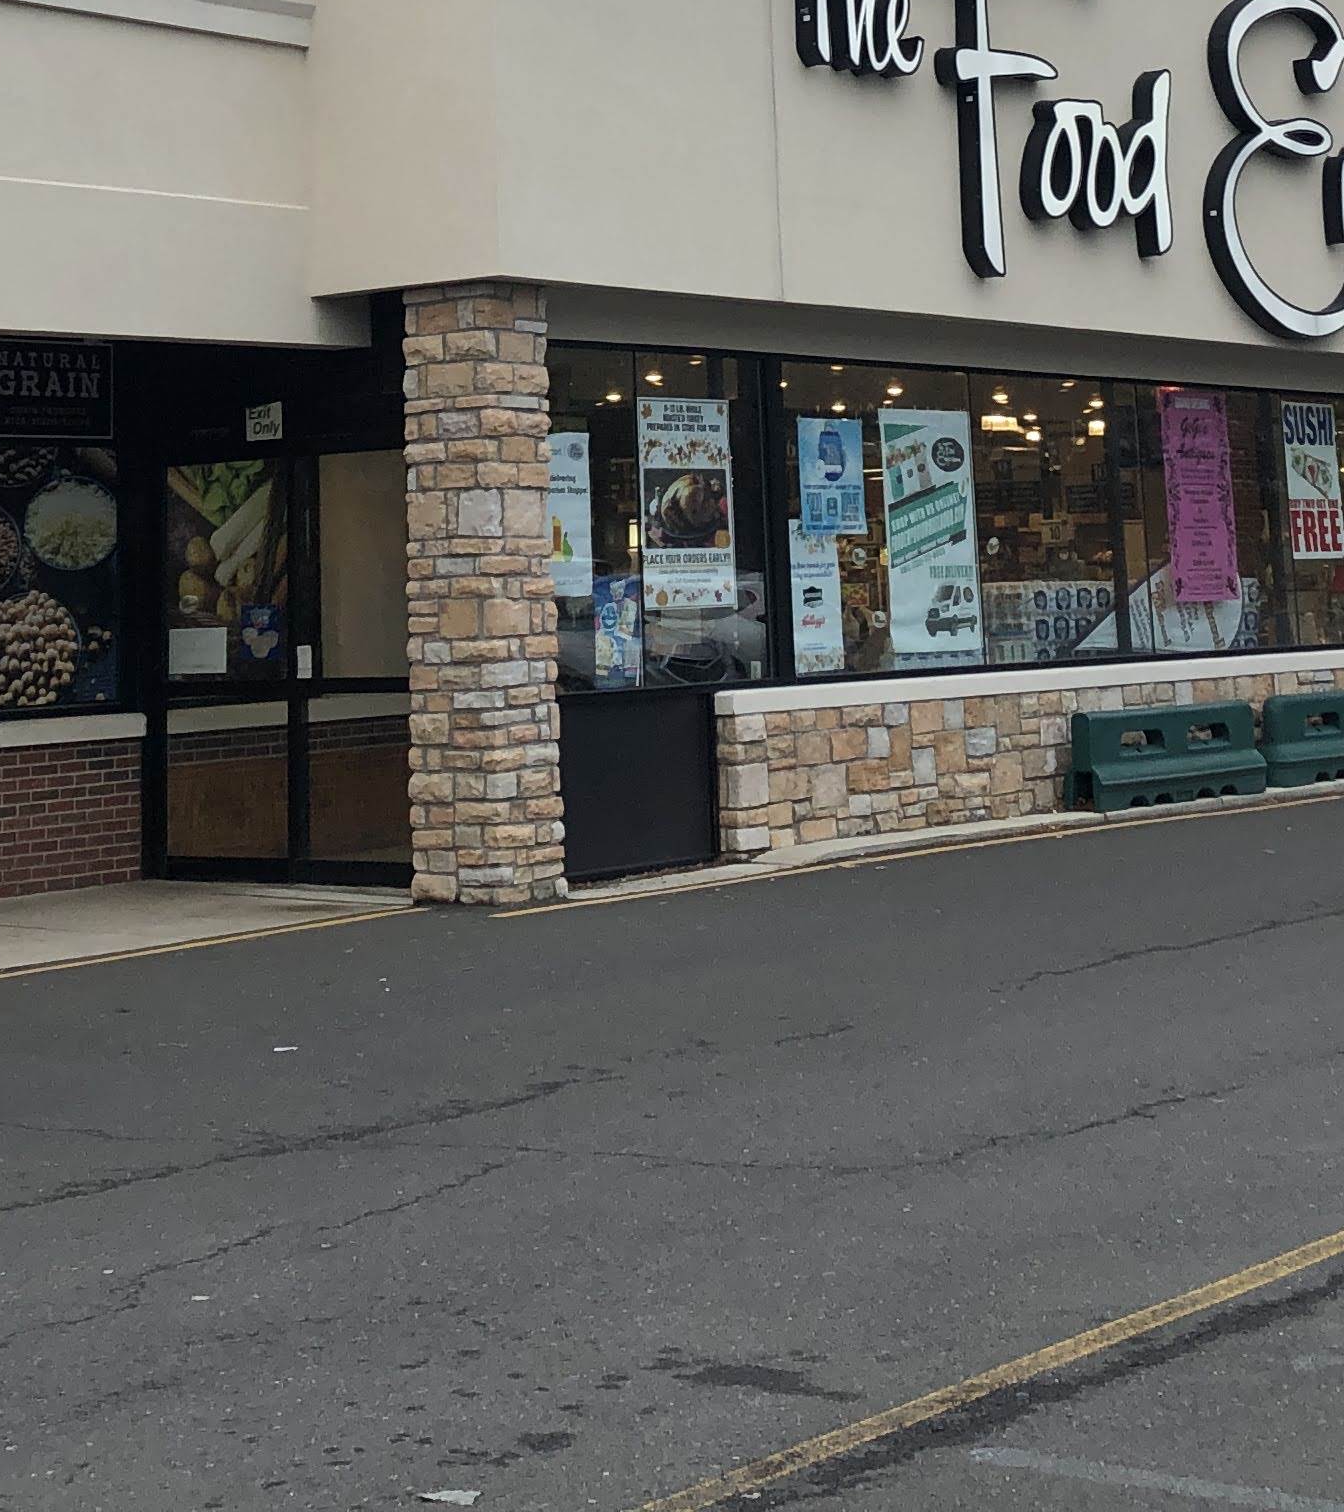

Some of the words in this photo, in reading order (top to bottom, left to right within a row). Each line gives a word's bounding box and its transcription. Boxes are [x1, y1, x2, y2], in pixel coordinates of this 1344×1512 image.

[249, 406, 271, 420] Exit
[253, 420, 280, 437] Only
[1283, 404, 1333, 445] SUSHI
[1290, 510, 1343, 552] FREE
[683, 553, 707, 563] ORDERS
